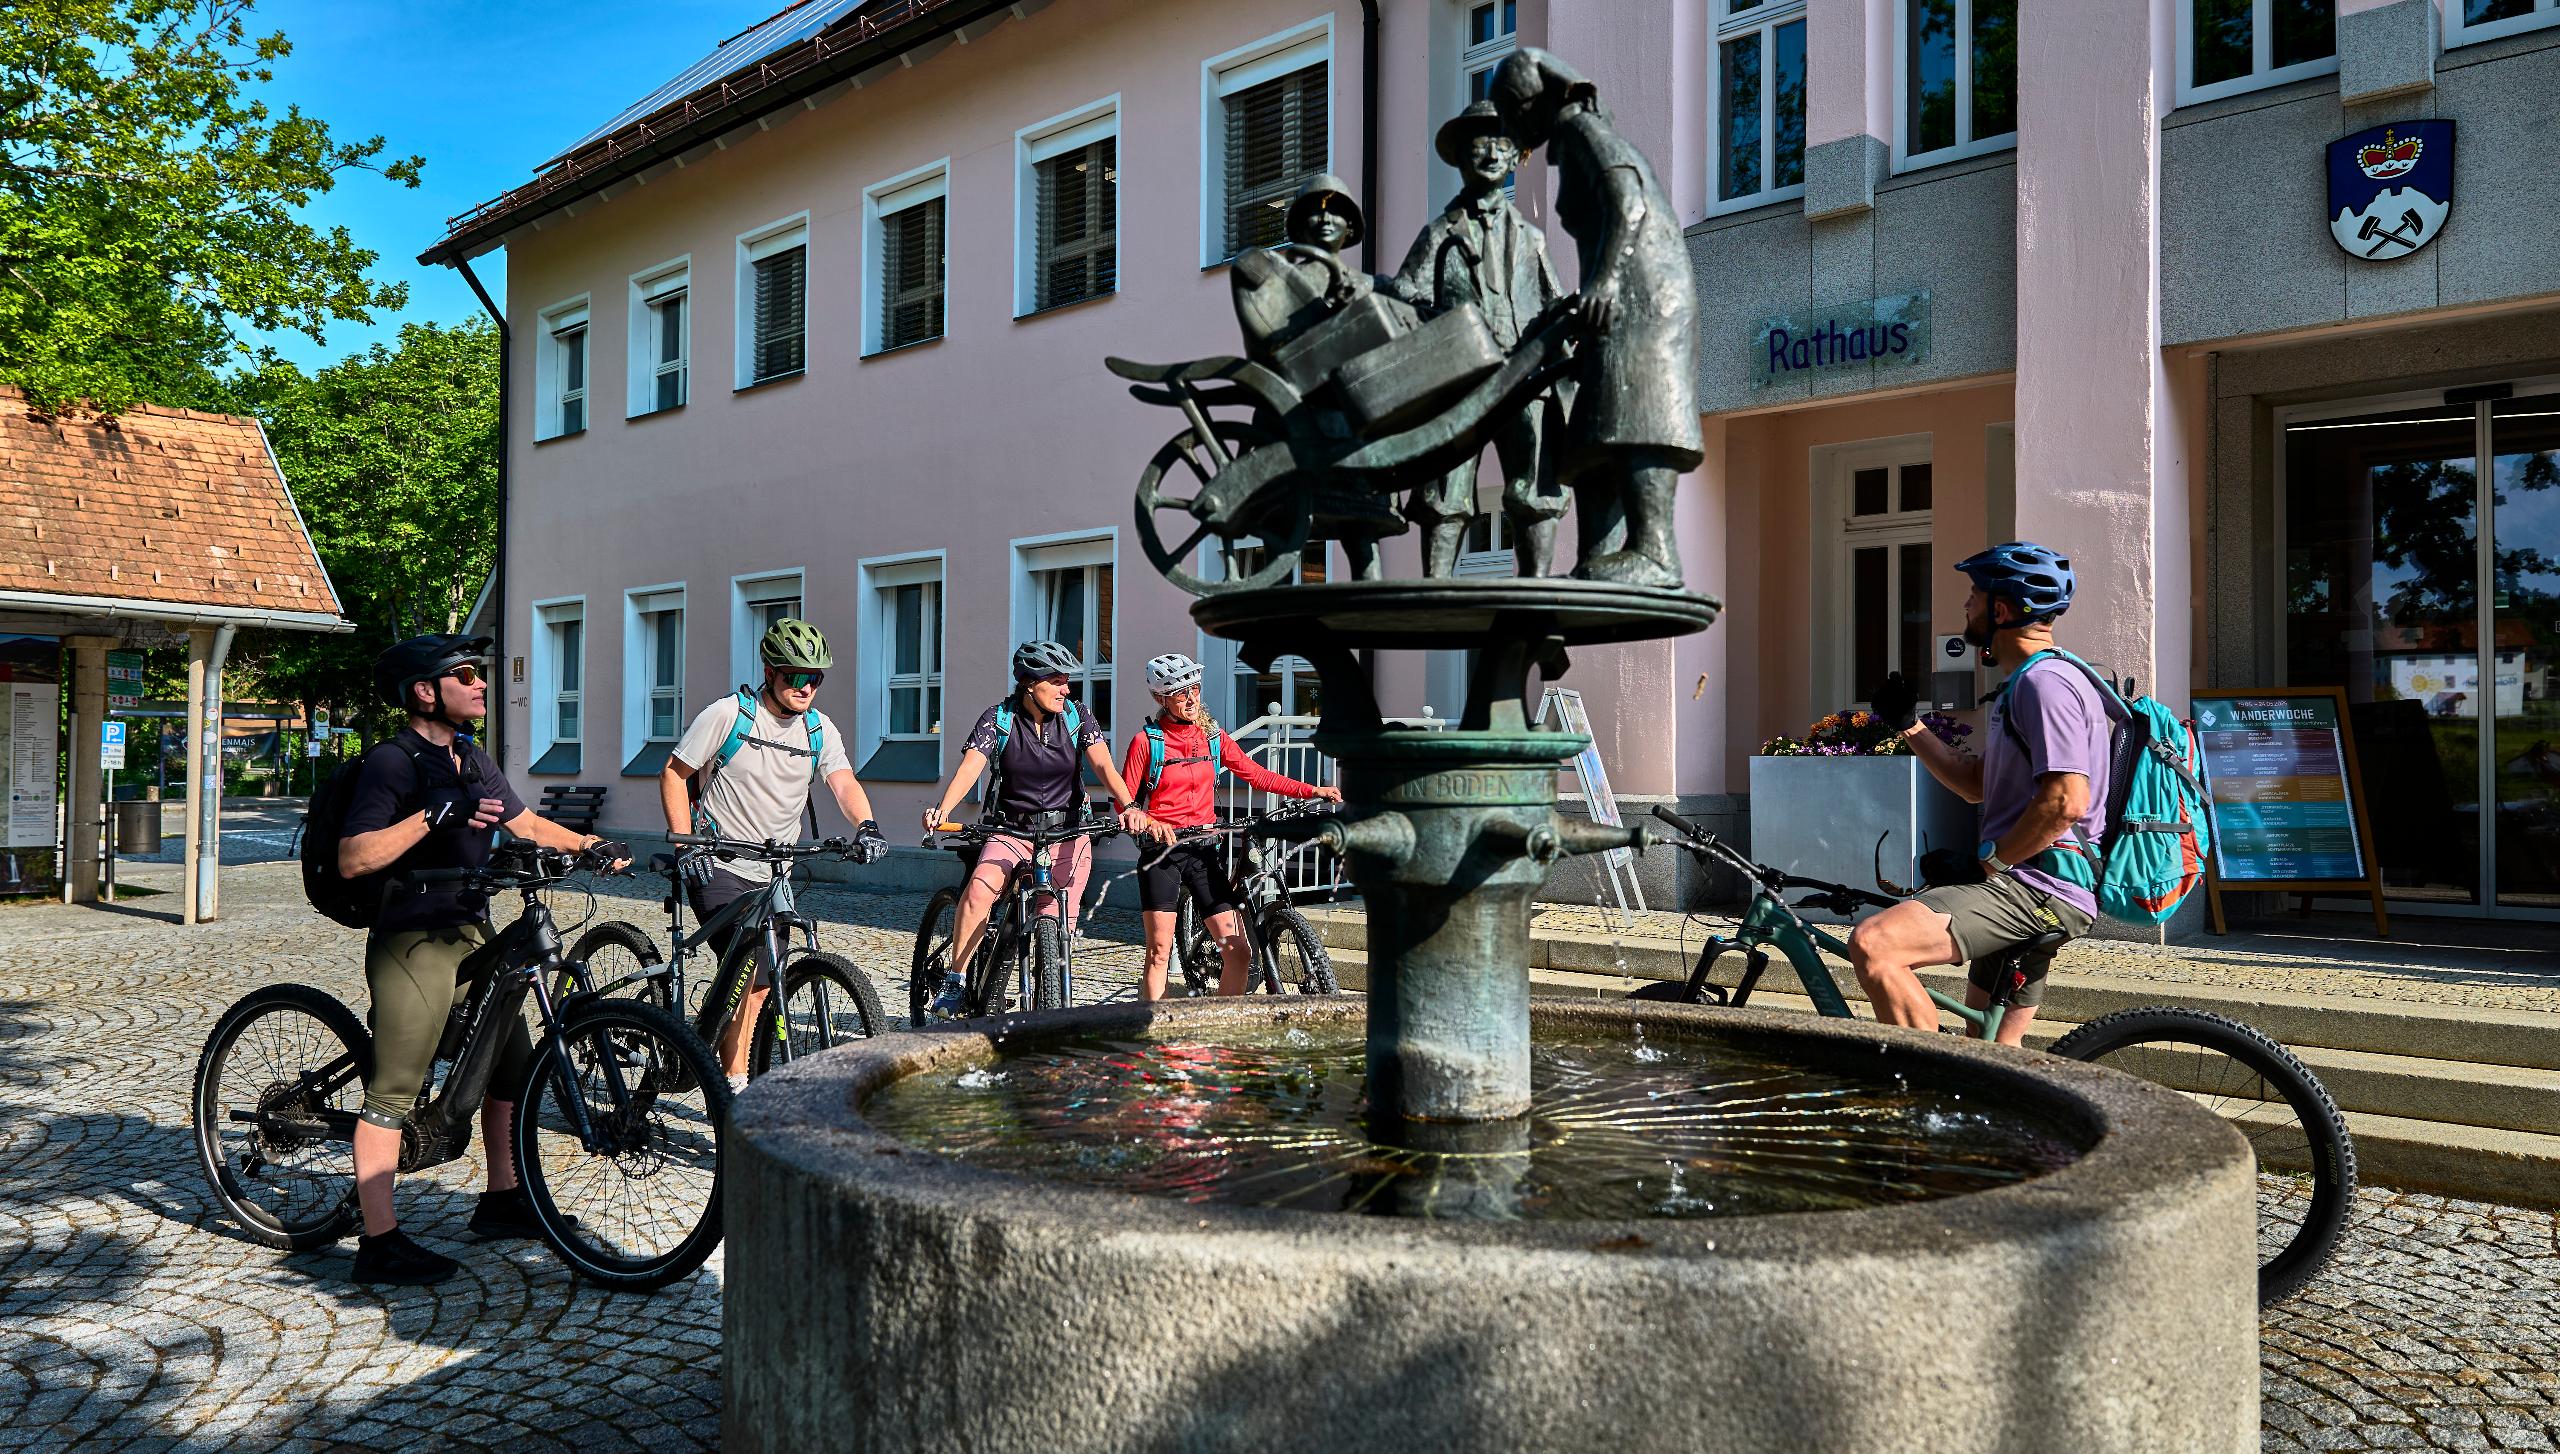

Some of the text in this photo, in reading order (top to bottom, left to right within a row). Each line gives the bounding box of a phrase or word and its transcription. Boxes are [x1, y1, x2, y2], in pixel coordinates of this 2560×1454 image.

[1769, 320, 1909, 373] Rathaus
[518, 696, 528, 708] WC
[2231, 709, 2315, 721] WANDERWOCHE
[106, 725, 120, 742] P
[726, 958, 755, 1014] HARDNINE
